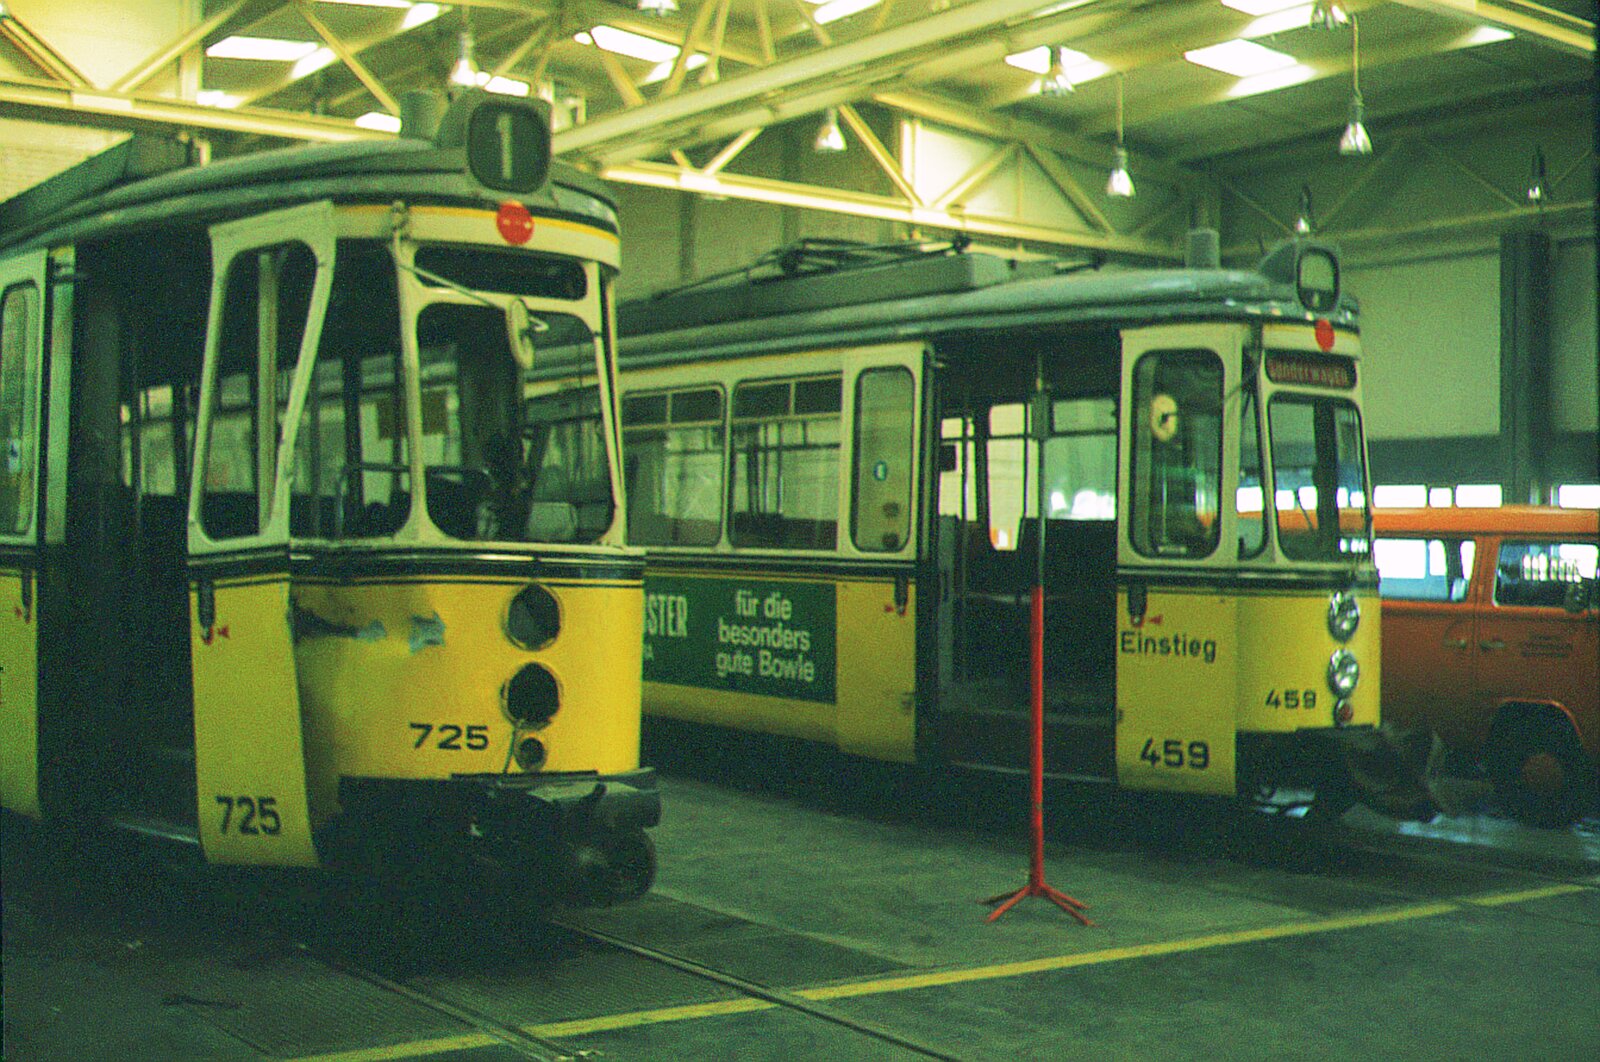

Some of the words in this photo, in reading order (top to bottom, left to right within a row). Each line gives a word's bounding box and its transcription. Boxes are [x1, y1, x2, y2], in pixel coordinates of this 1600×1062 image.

[495, 112, 513, 179] 1
[736, 589, 760, 616] für
[764, 591, 792, 620] die
[718, 616, 811, 651] besonders
[1120, 630, 1217, 664] Einstieg
[716, 650, 754, 678] gute
[758, 649, 814, 682] Bowle
[1265, 688, 1317, 710] 459
[409, 722, 490, 751] 725
[1141, 737, 1210, 770] 459
[215, 795, 282, 836] 725
